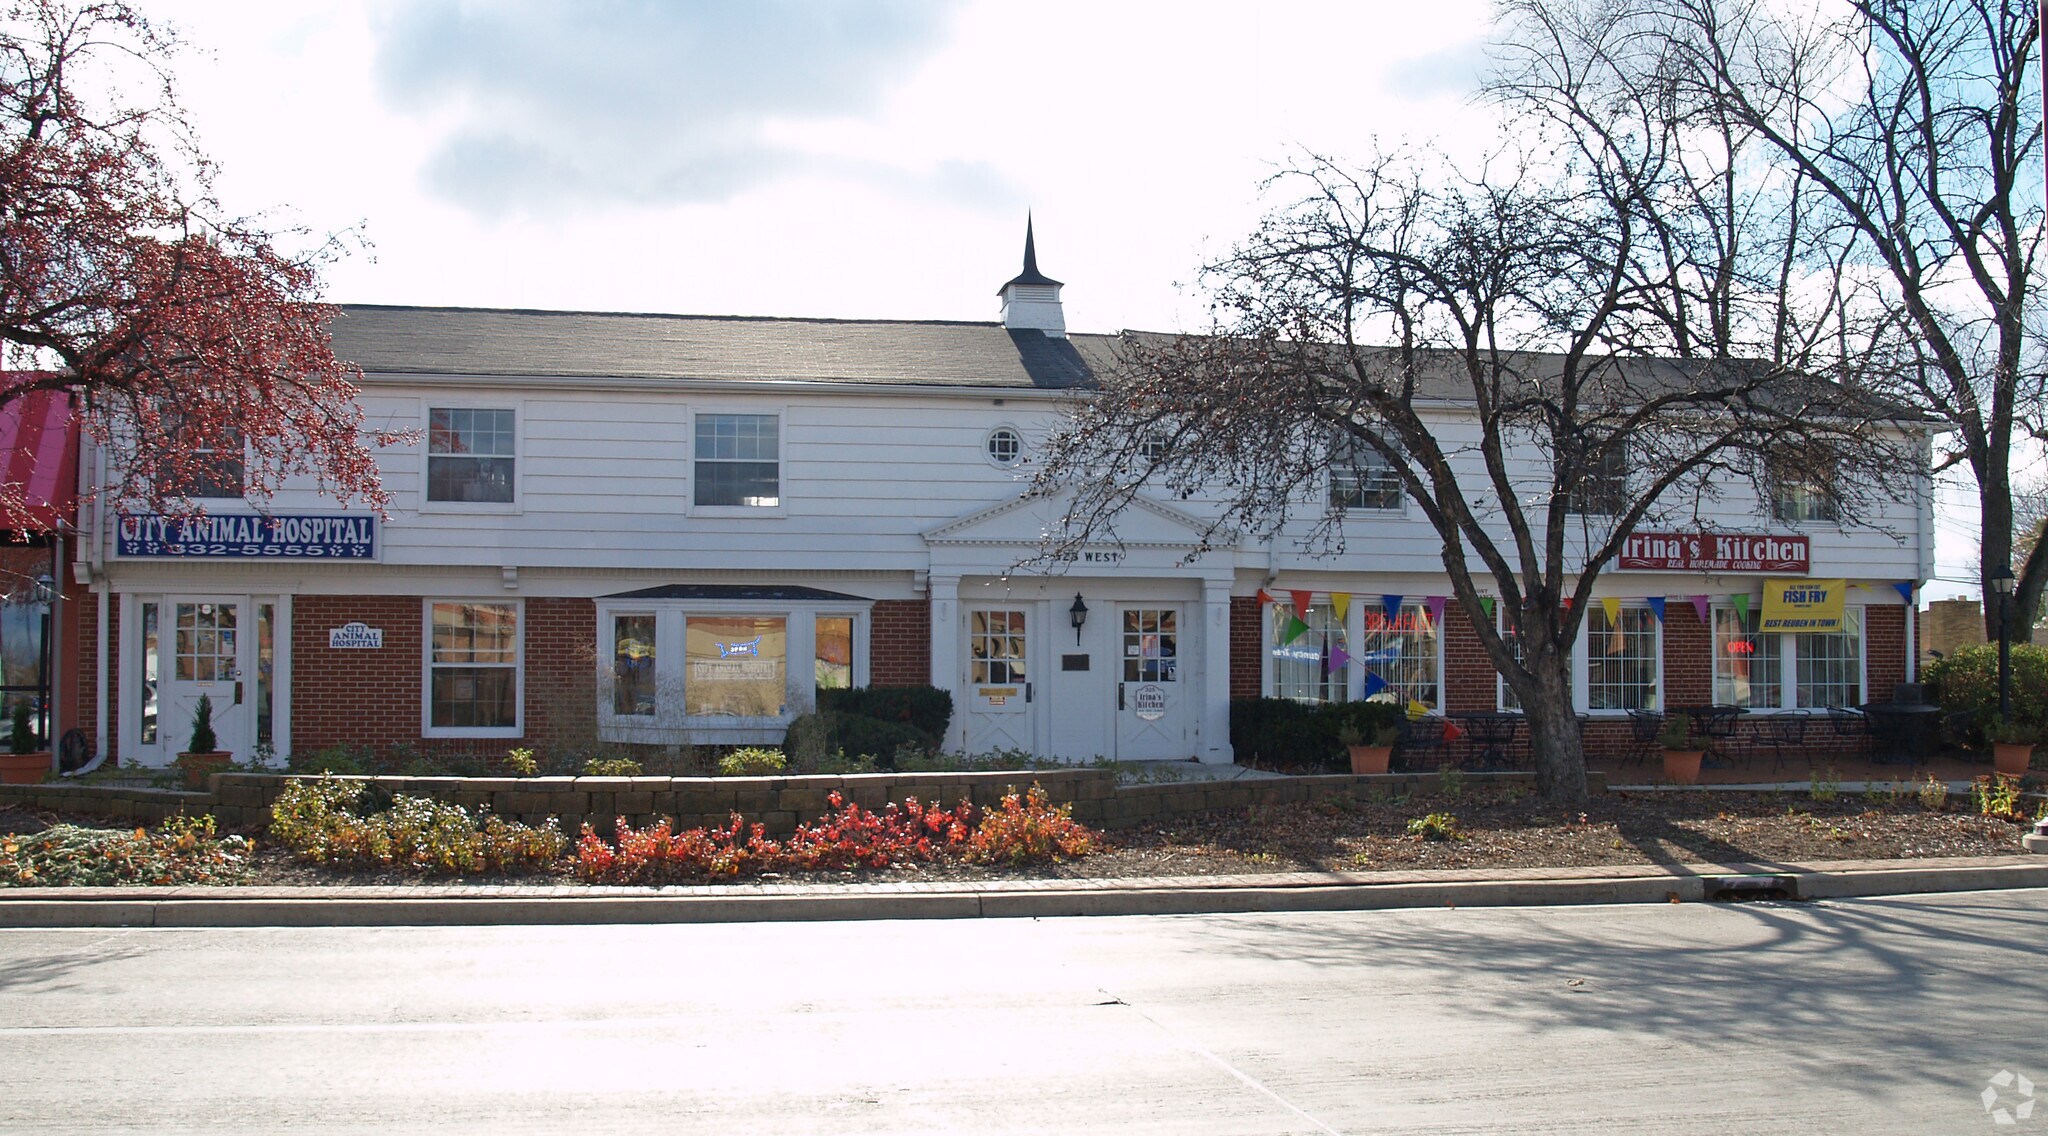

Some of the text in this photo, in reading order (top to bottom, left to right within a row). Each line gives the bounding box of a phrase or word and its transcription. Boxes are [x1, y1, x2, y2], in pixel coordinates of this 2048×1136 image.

[120, 516, 371, 544] CITY ANIMAL HOSPITAL
[1621, 536, 1806, 561] Irina's Kitchen
[1085, 552, 1118, 563] WEST
[1666, 559, 1762, 571] REAL HOMEMADE COOKING
[1782, 590, 1827, 603] FISH FRY
[1764, 619, 1781, 628] BEST
[1782, 619, 1808, 628] REUBEN
[1809, 619, 1816, 628] IN
[345, 625, 366, 633] CITY
[333, 632, 379, 640] ANIMAL
[331, 640, 380, 648] HOSPITAL
[1727, 641, 1754, 653] OPEN
[1139, 693, 1162, 701] Irina's
[1137, 701, 1164, 709] Kitchen
